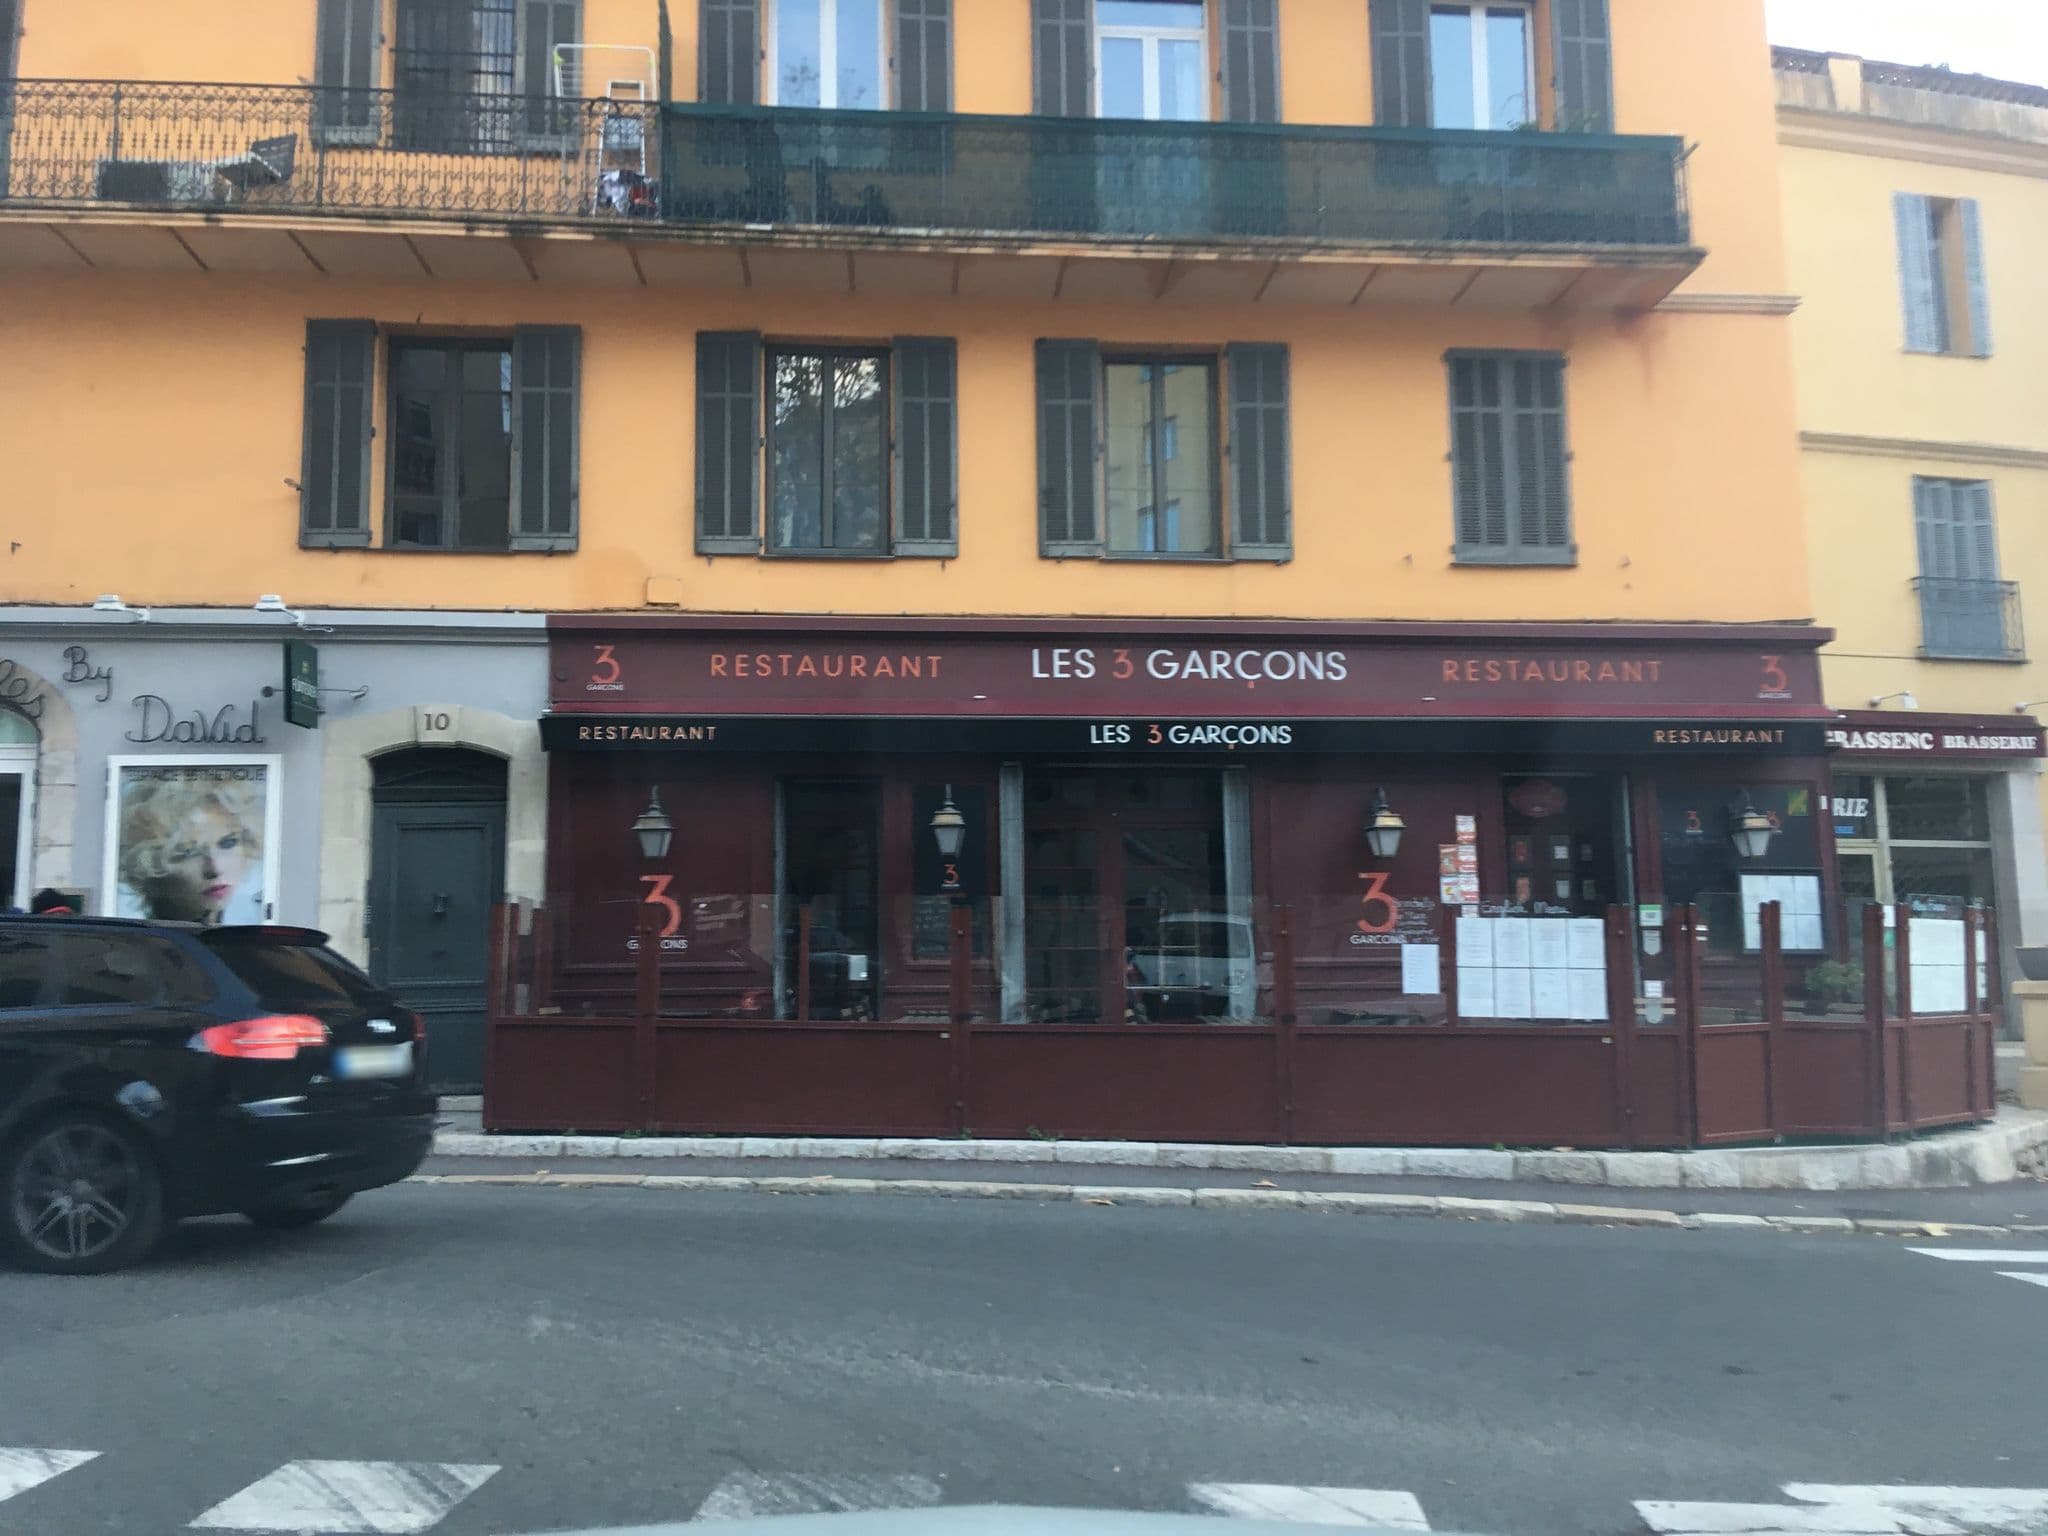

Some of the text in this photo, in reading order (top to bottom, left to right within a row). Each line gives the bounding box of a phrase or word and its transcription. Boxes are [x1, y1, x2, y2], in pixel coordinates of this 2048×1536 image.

[62, 645, 114, 702] By
[592, 645, 621, 684] 3
[710, 654, 943, 678] RESTAURANT
[1032, 648, 1348, 688] LES 3 GARÇONS
[1441, 659, 1664, 683] RESTAURANT
[1759, 655, 1788, 692] 3
[423, 713, 450, 731] 10
[578, 726, 717, 741] RESTAURANT
[1090, 725, 1293, 749] LES 3 GARÇONS
[1653, 730, 1784, 743] RESTAURANT
[1941, 735, 2038, 750] BRASSERIE
[943, 863, 959, 884] 3
[640, 874, 682, 936] 3
[1357, 872, 1398, 933] 3
